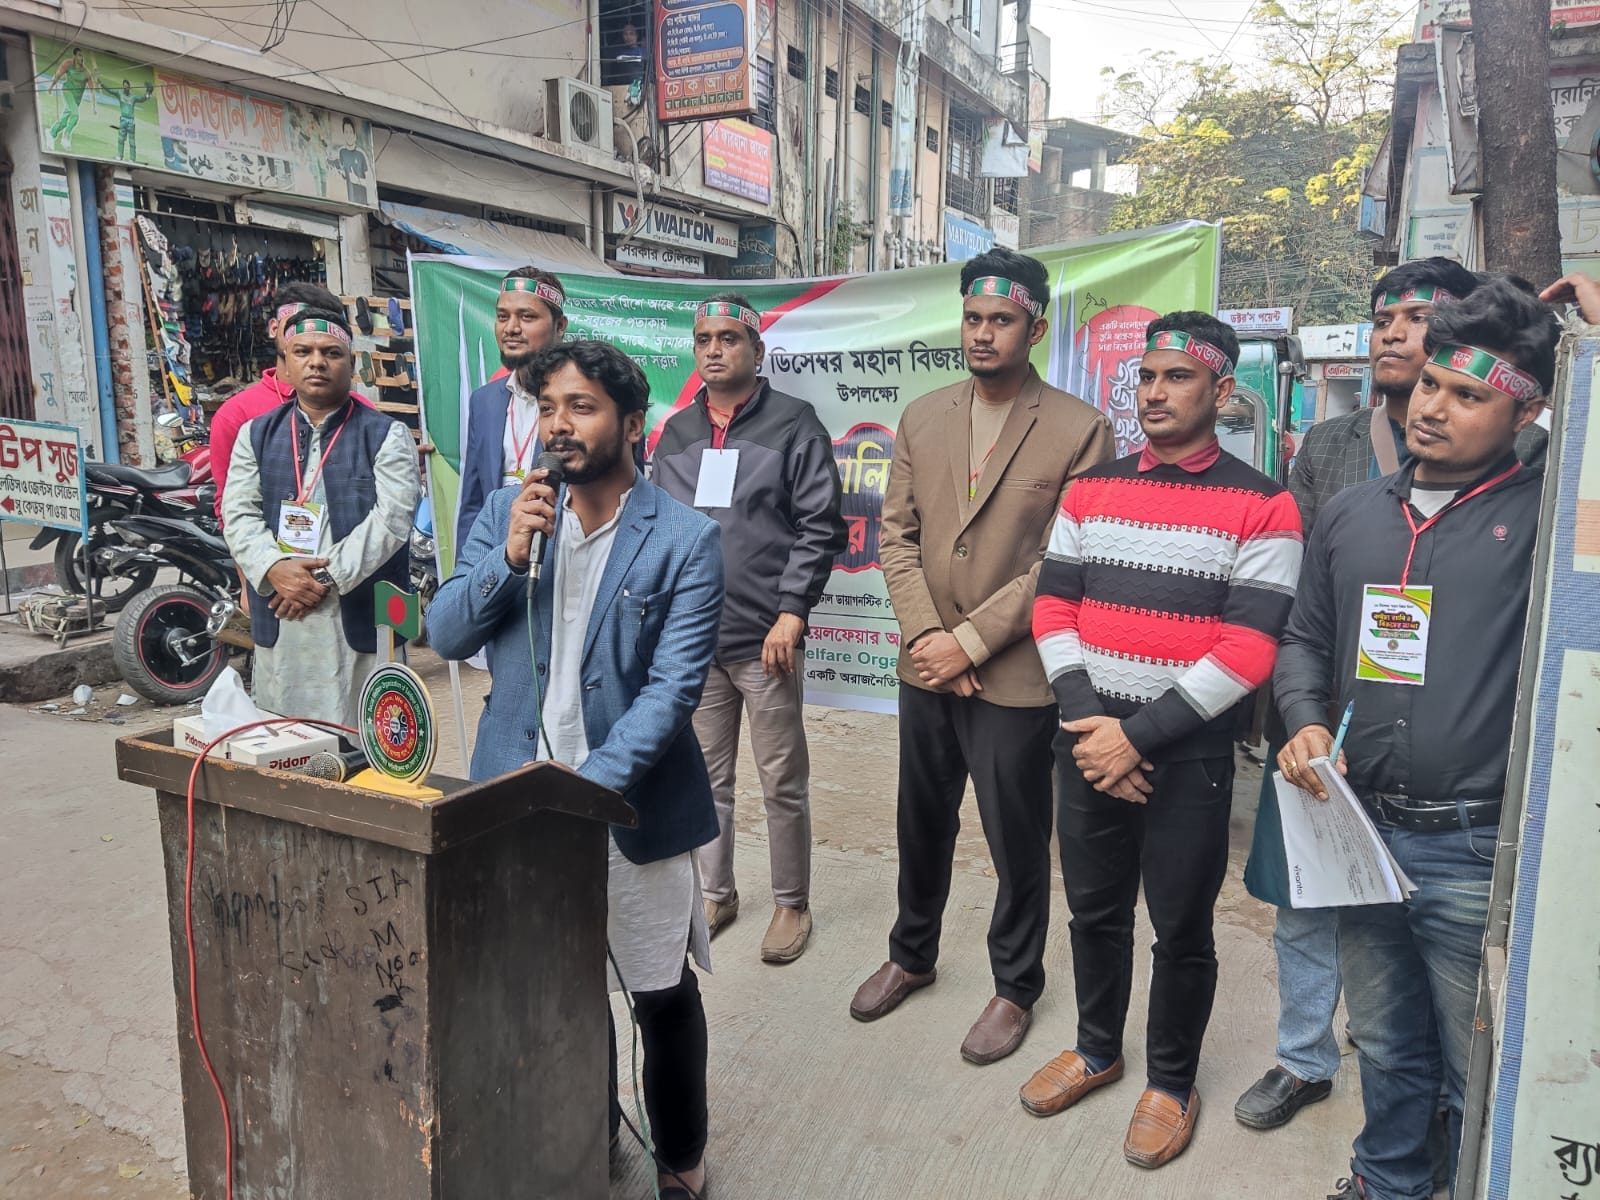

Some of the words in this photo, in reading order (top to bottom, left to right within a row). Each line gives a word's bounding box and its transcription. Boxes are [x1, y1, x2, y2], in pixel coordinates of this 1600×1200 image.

[655, 211, 714, 244] WALTON
[716, 237, 737, 248] MOBILE
[947, 223, 992, 252] MARVELOUS
[621, 243, 658, 262] সরকার
[662, 248, 700, 268] টেলিকম
[648, 299, 675, 312] আছে
[627, 317, 668, 330] পতাকায়
[769, 347, 843, 374] ডিসেম্বর
[849, 347, 903, 376] মহান
[908, 340, 966, 373] বিজয়
[836, 382, 899, 403] উপলক্ষ্যে
[46, 503, 68, 520] পাওয়া
[836, 593, 882, 608] ডায়াগনস্টিক
[806, 648, 852, 663] elfare
[858, 651, 898, 670] Orga
[807, 668, 836, 681] একটি
